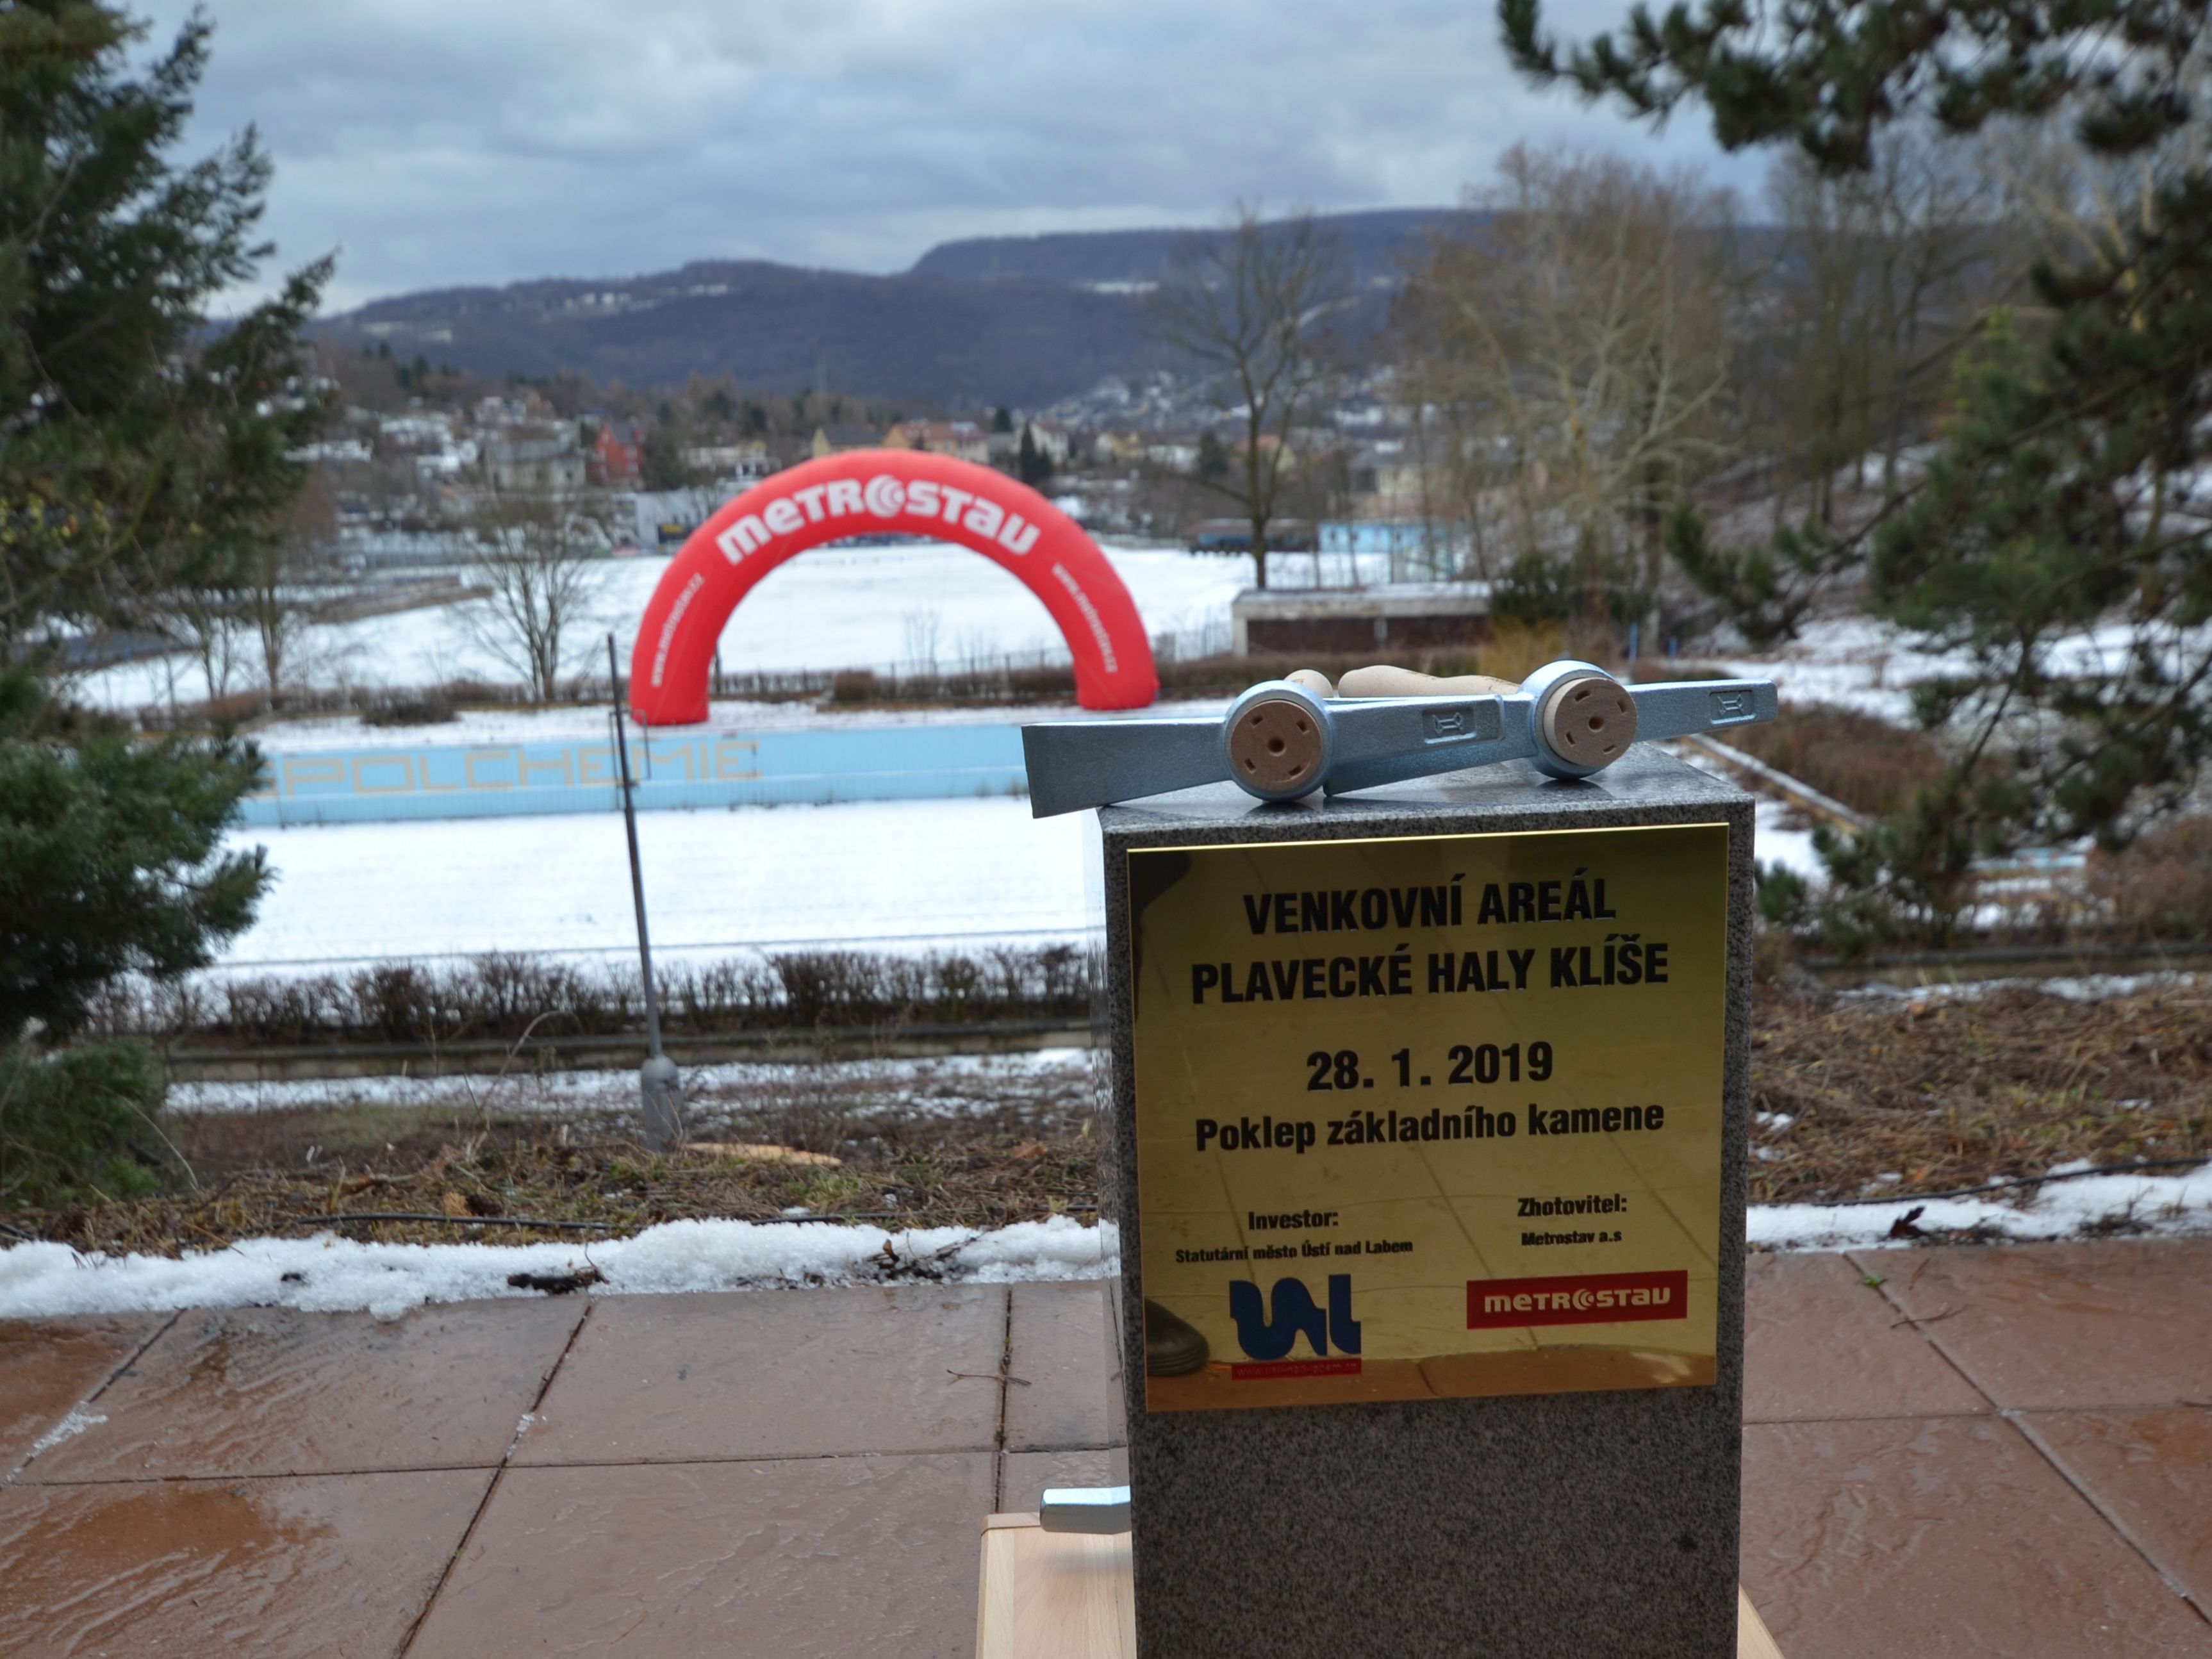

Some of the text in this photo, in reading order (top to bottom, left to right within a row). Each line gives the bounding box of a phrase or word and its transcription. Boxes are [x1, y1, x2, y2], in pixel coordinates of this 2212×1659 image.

[1243, 867, 1615, 934] VENKOVNÍ AREÁL
[1192, 934, 1667, 1004] PLAVECKÉ HALY KLÍŠE
[1307, 1050, 1373, 1091] 28.
[1448, 1041, 1552, 1084] 2019
[1196, 1103, 1663, 1153] Poklep základního kamene
[1248, 1209, 1339, 1230] Investor:
[1517, 1193, 1627, 1217] Zhotovitel:
[1175, 1239, 1413, 1264] Statutární město Ústí nad Labem
[1521, 1230, 1596, 1246] Metrostav
